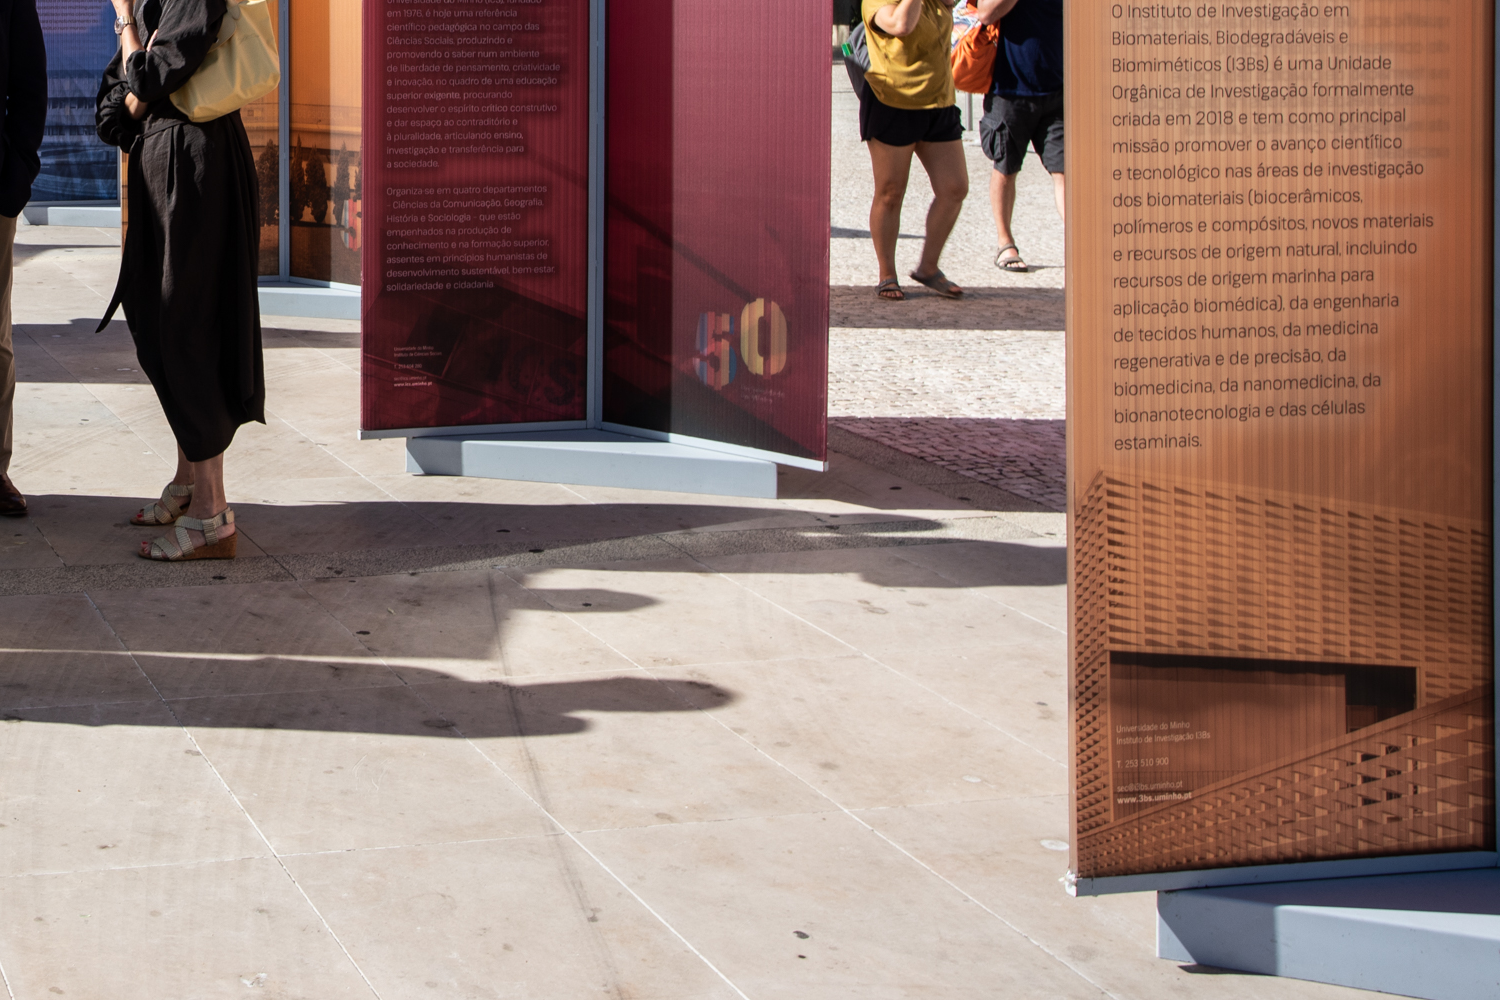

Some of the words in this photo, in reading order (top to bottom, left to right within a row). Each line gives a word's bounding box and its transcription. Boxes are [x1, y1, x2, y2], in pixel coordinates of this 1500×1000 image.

[1112, 4, 1122, 18] O
[1127, 4, 1192, 18] Instituto
[1196, 4, 1216, 18] de
[1221, 4, 1319, 21] Investigação
[1324, 6, 1349, 18] em
[1112, 31, 1212, 46] Biomateriais,
[1216, 30, 1335, 46] Biodegradáveis
[1339, 32, 1348, 43] e
[1112, 57, 1221, 72] Biomiméticos
[1226, 56, 1268, 73] (I3Bs)
[1273, 57, 1283, 70] é
[1288, 58, 1323, 70] uma
[1328, 56, 1391, 70] Unidade
[1112, 84, 1181, 102] Orgânica
[1186, 84, 1206, 98] de
[1210, 83, 1308, 101] Investigação
[1312, 82, 1414, 98] formalmente
[1113, 111, 1161, 127] criada
[1165, 113, 1191, 126] em
[1196, 111, 1233, 125] 2018
[1238, 113, 1248, 124] e
[1252, 111, 1284, 124] tem
[1288, 111, 1334, 124] como
[1339, 108, 1405, 126] principal
[1113, 138, 1169, 154] missão
[1175, 138, 1252, 155] promover
[1257, 139, 1266, 151] o
[1270, 137, 1326, 153] avanço
[1331, 134, 1402, 150] científico
[1113, 168, 1122, 181] e
[1126, 165, 1220, 182] tecnológico
[1225, 166, 1252, 178] nas
[1256, 163, 1298, 177] áreas
[1303, 162, 1323, 176] de
[1328, 160, 1424, 178] investigação
[1113, 192, 1142, 207] dos
[1147, 190, 1244, 206] biomateriais
[1248, 189, 1362, 206] (biocerâmicos,
[1113, 218, 1193, 236] polímeros
[1198, 220, 1207, 232] e
[1212, 217, 1308, 234] compósitos,
[1312, 217, 1358, 230] novos
[1363, 214, 1434, 228] materiais
[1113, 248, 1122, 261] e
[1128, 247, 1196, 260] recursos
[1201, 245, 1221, 259] de
[1226, 244, 1281, 260] origem
[1286, 242, 1341, 257] natural,
[1346, 240, 1417, 255] incluindo
[693, 298, 787, 390] 50
[1116, 724, 1158, 733] Universidade
[1156, 757, 1169, 765] 900
[1117, 792, 1192, 804] www.3bs.uminho.pt
